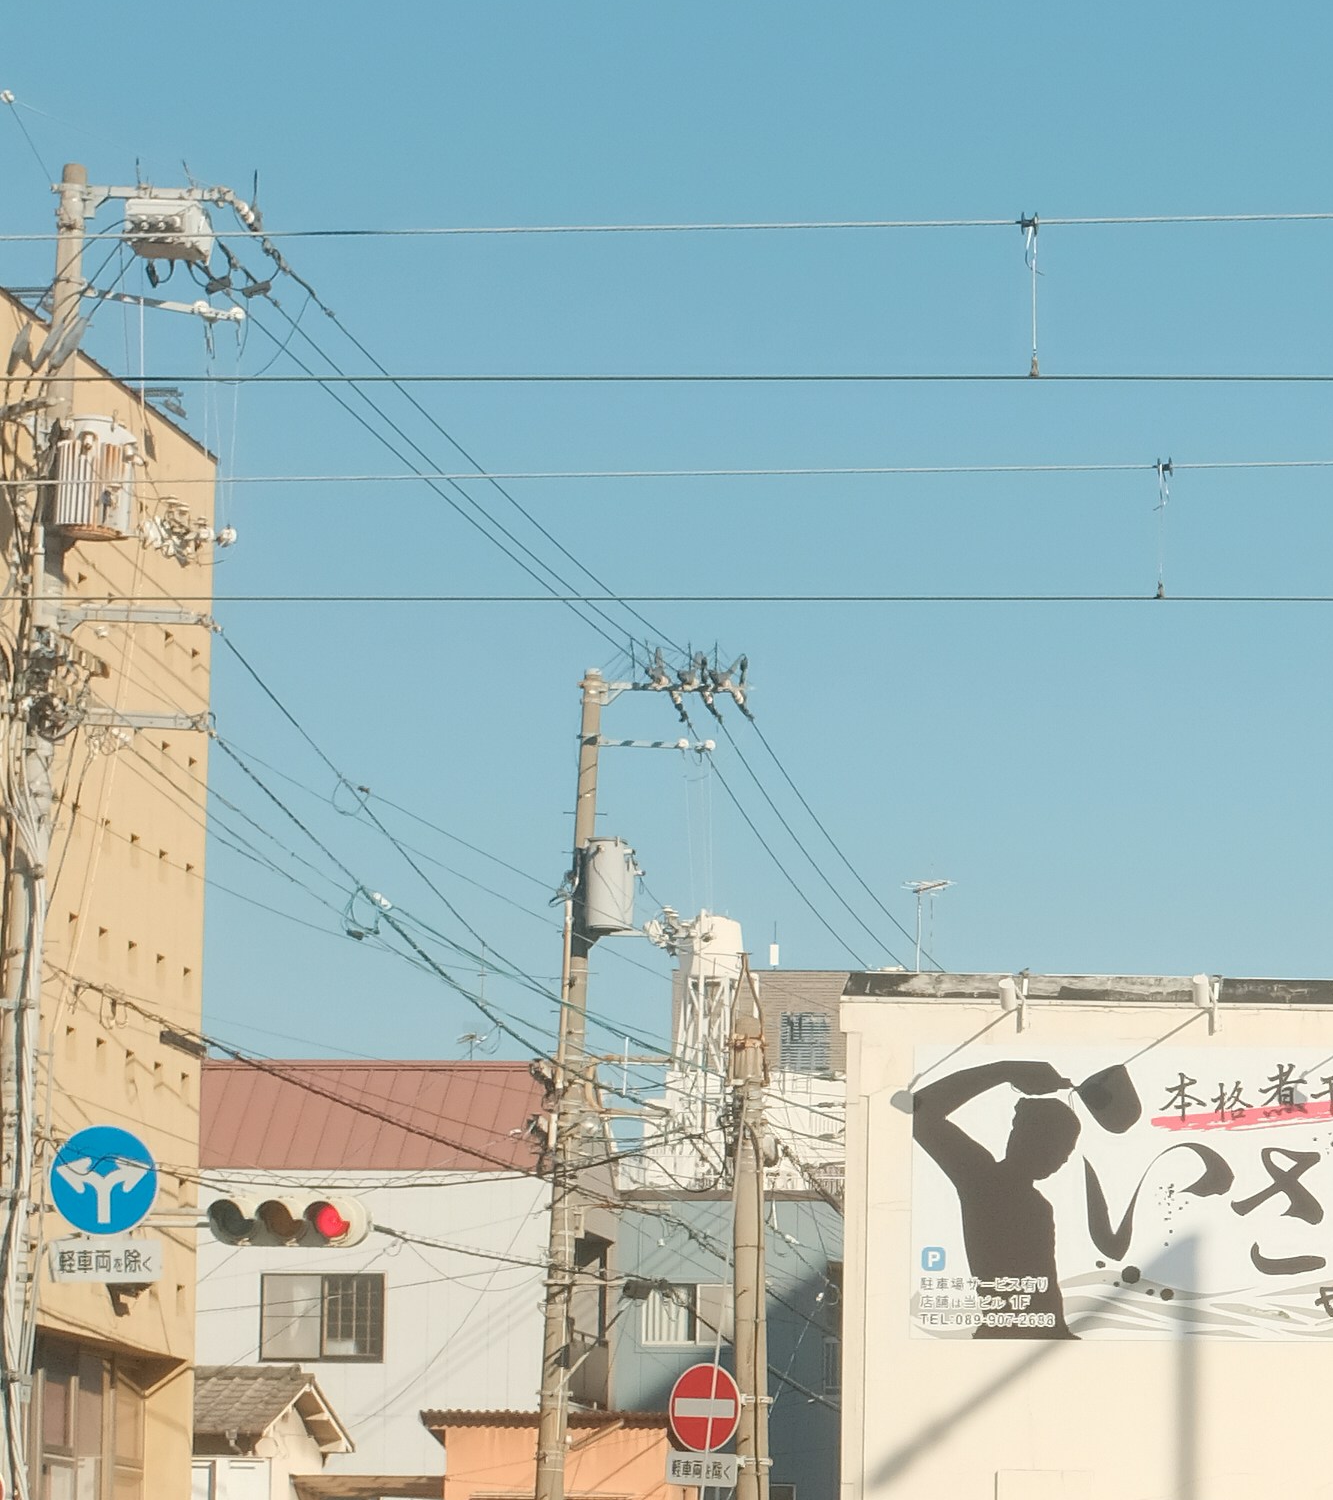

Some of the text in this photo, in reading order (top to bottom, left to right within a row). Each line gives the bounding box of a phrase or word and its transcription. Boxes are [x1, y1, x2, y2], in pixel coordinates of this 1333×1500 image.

[59, 1249, 152, 1273] 軽車両を除く
[920, 1277, 1049, 1293] 駐車場サービス有り
